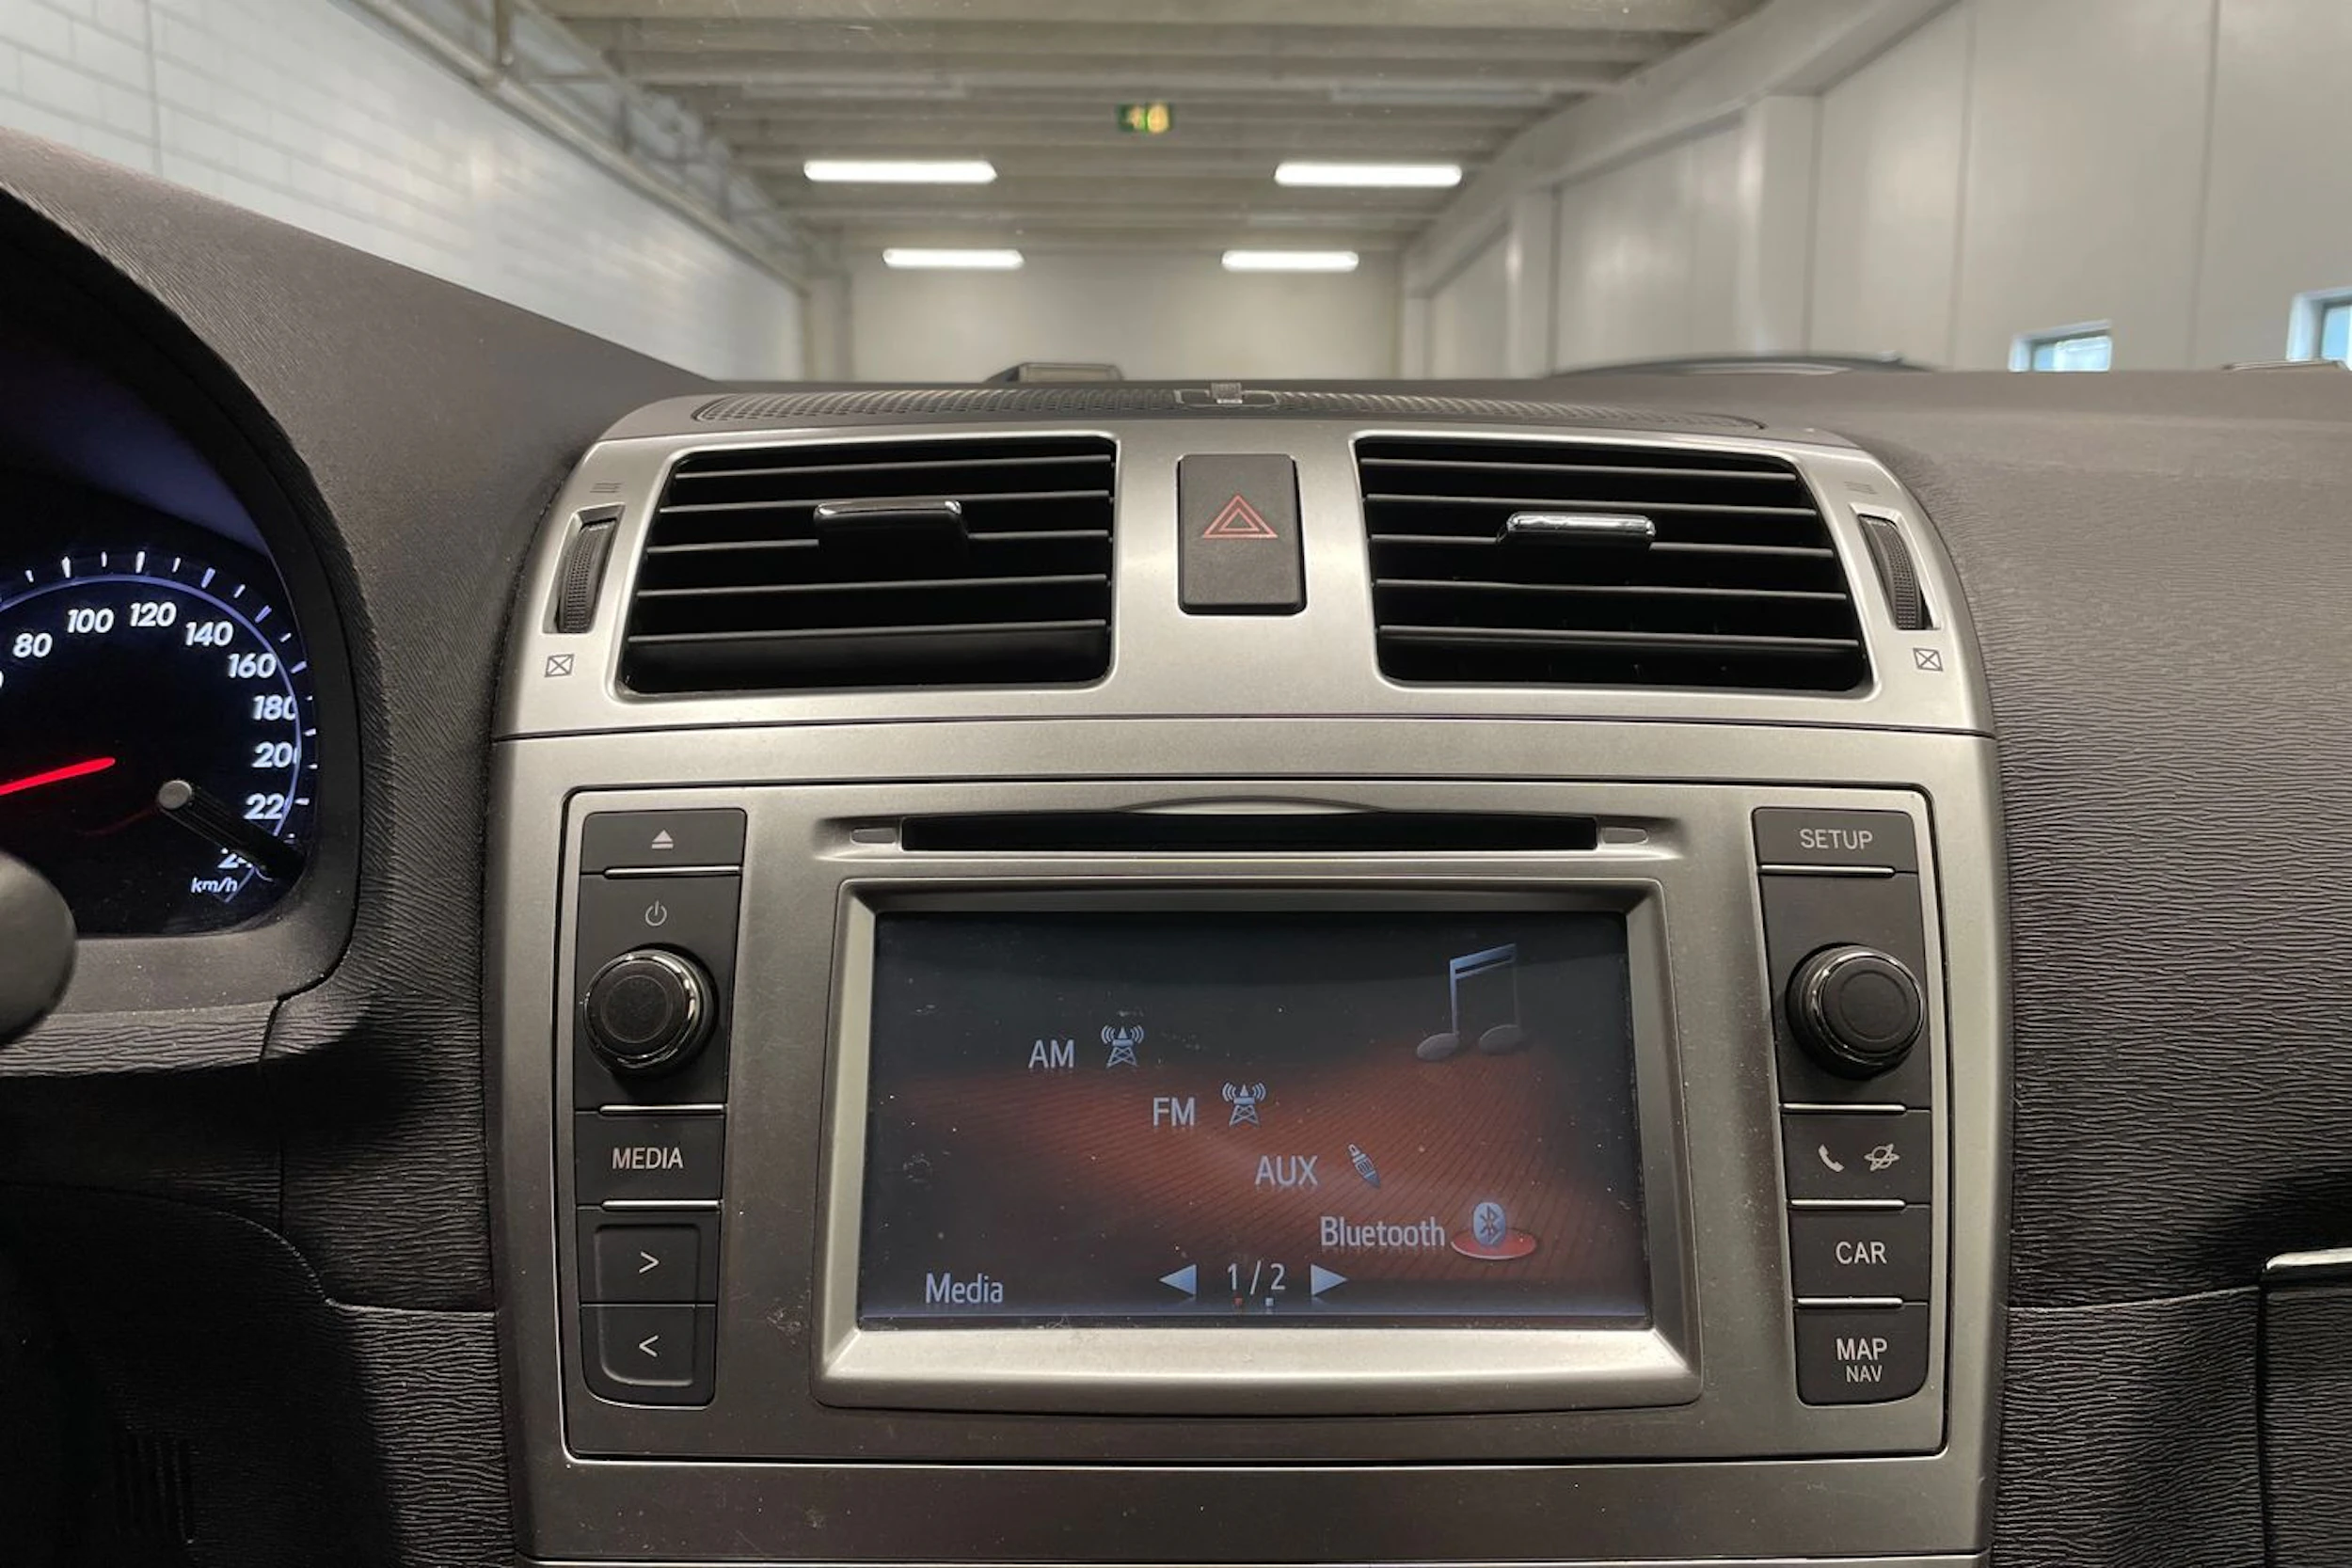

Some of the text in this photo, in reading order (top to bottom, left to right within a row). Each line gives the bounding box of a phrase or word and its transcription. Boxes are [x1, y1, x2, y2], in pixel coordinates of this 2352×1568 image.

[67, 608, 115, 634] 100
[130, 601, 177, 627] 120
[12, 632, 53, 658] 80
[185, 621, 233, 646] 140
[228, 653, 277, 678] 160
[244, 792, 291, 820] 22
[1799, 829, 1873, 849] SETUP
[191, 876, 239, 894] km/h
[1028, 1039, 1075, 1069] AM
[1152, 1097, 1195, 1126] FM
[612, 1147, 684, 1170] MEDIA
[1254, 1155, 1318, 1185] AUX
[1320, 1215, 1446, 1246] Bluetooth
[1836, 1241, 1887, 1264] CAR
[925, 1273, 1004, 1304] Media
[1836, 1338, 1888, 1361] MAP
[1846, 1365, 1883, 1383] NAV
